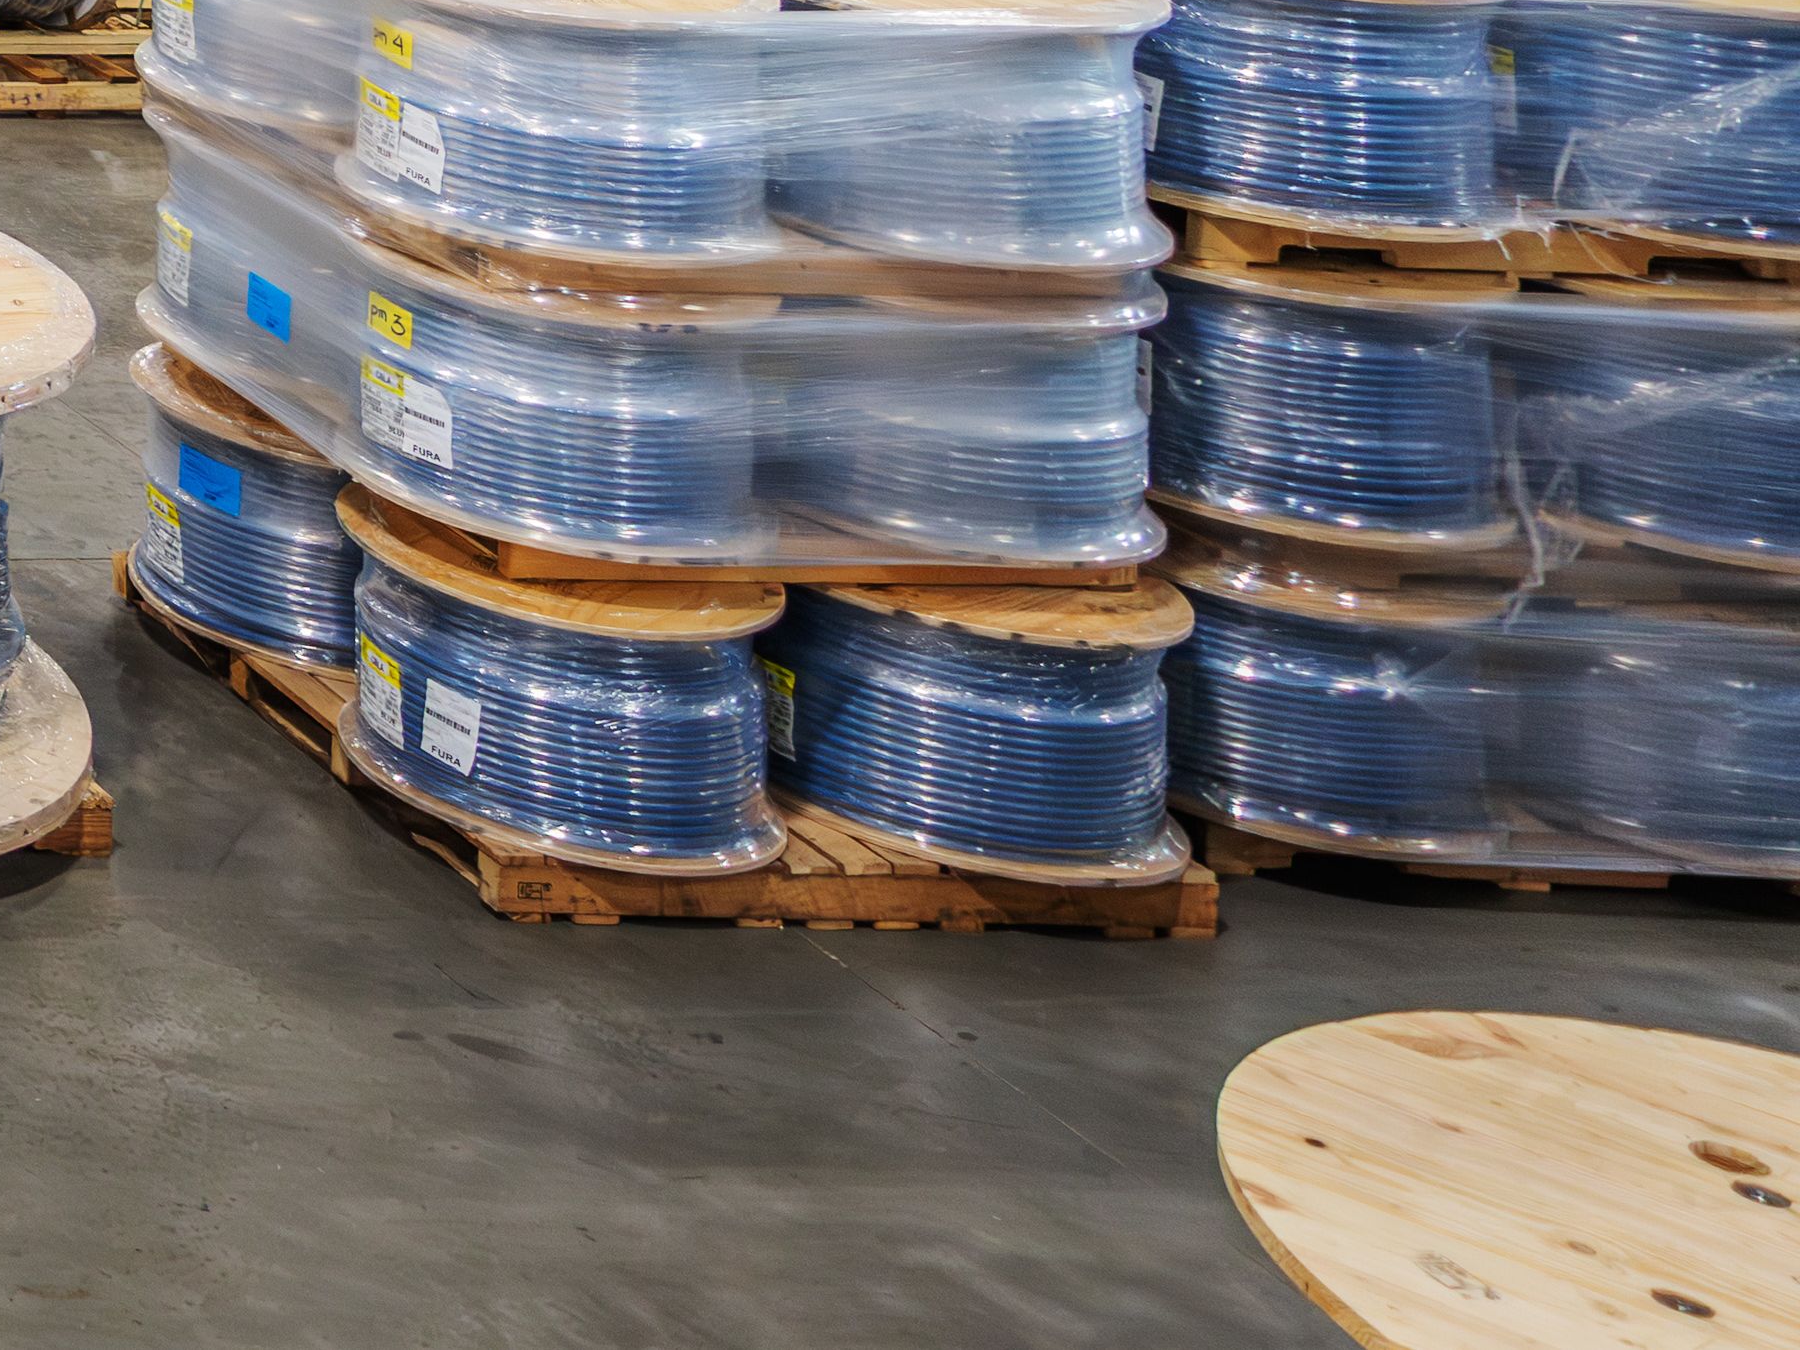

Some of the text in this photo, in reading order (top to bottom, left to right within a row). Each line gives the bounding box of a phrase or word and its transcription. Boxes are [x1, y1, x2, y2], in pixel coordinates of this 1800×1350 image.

[392, 34, 404, 56] 4
[405, 166, 432, 187] FURA
[370, 304, 407, 336] pm 3
[412, 444, 442, 463] FURA
[431, 745, 462, 768] FURA
